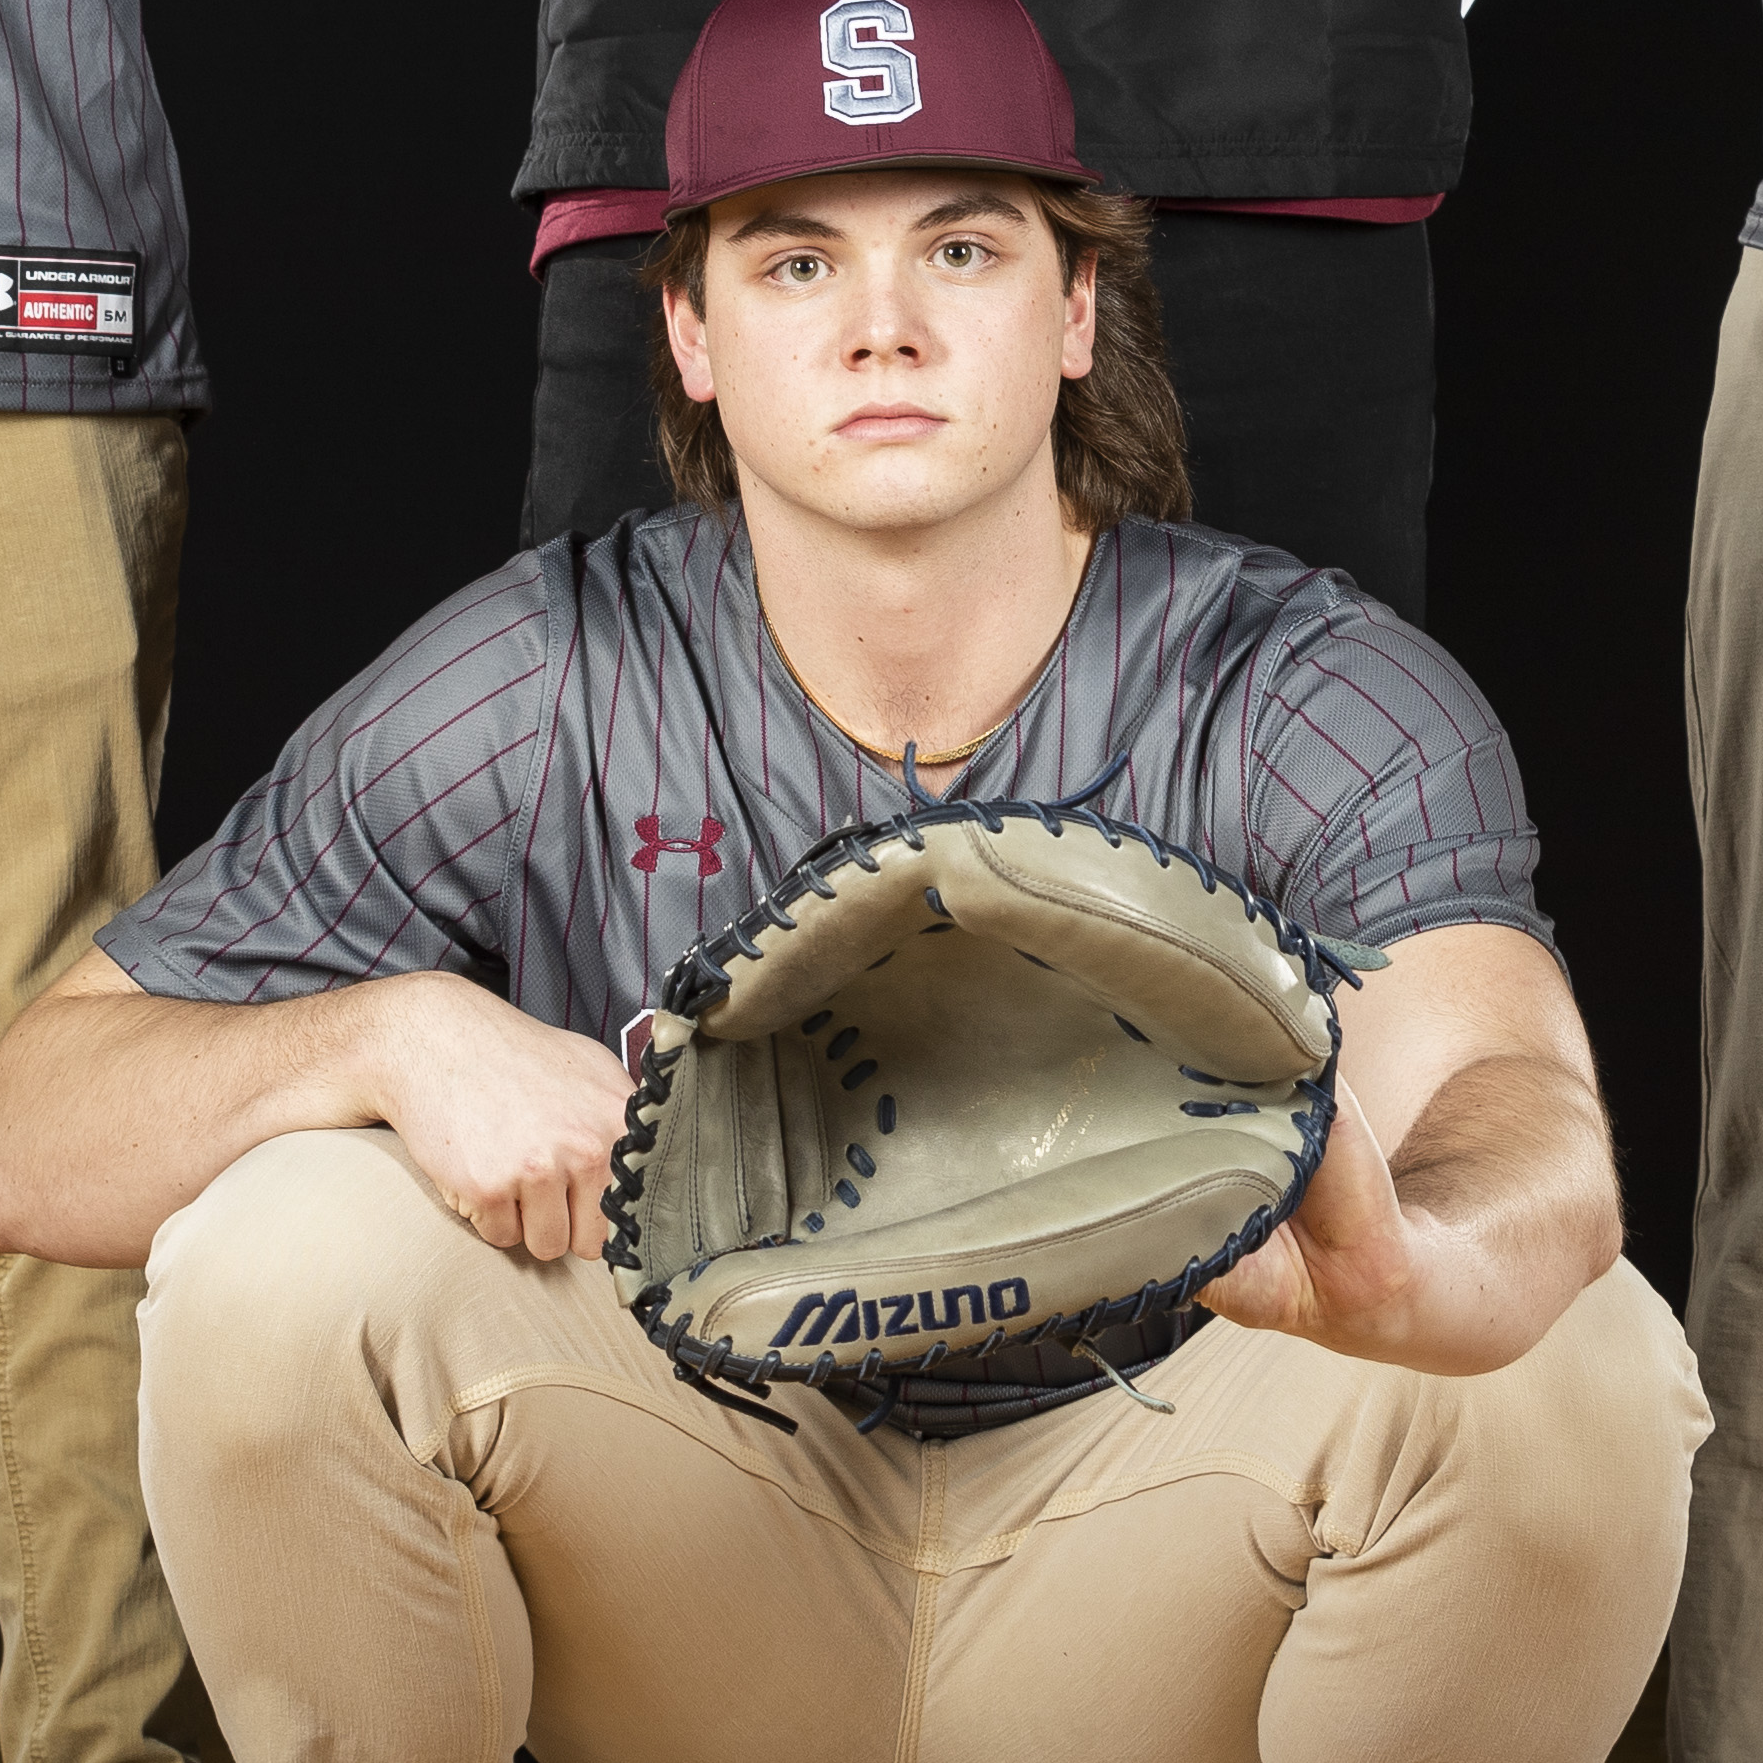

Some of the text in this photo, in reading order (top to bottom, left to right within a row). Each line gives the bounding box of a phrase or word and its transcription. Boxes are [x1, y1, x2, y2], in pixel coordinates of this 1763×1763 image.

[25, 270, 131, 285] UNDER ARMOUR
[23, 301, 128, 323] AUTHENTIC SM
[5, 331, 62, 341] GUARANTEE
[64, 334, 76, 342] OF
